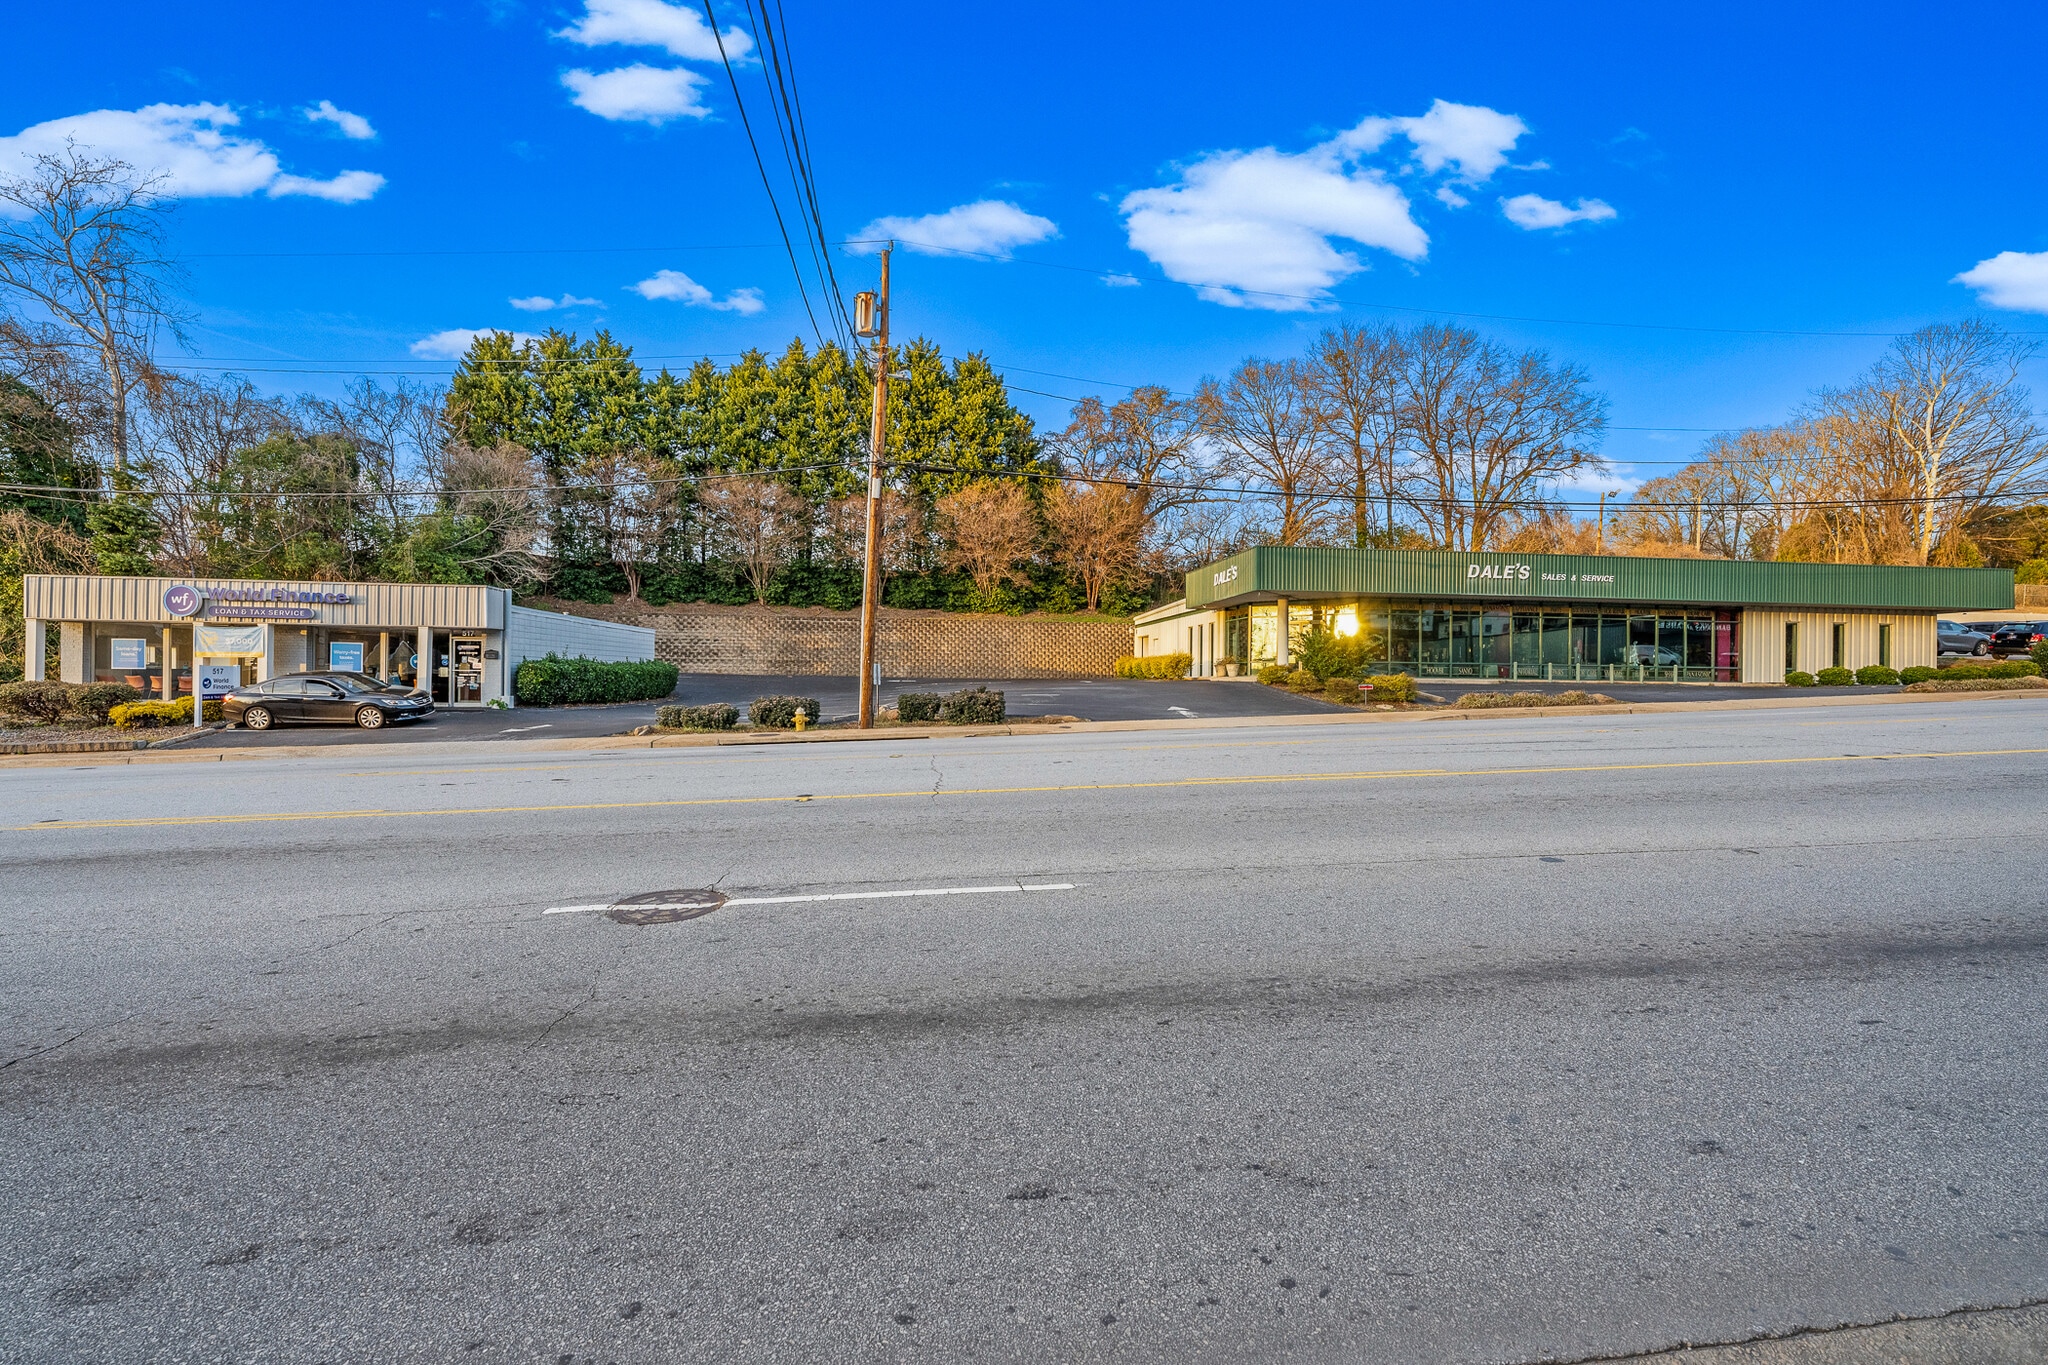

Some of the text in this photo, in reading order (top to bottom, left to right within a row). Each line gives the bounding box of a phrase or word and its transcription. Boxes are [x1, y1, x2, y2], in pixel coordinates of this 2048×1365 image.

[1213, 565, 1238, 586] DALE'S
[1467, 563, 1531, 580] DALE'S
[1541, 573, 1567, 581] SALES
[1581, 574, 1614, 583] SERVICE
[171, 592, 190, 606] wf
[207, 587, 350, 605] World Finance
[250, 608, 266, 616] TAX
[268, 609, 305, 617] SERVICE
